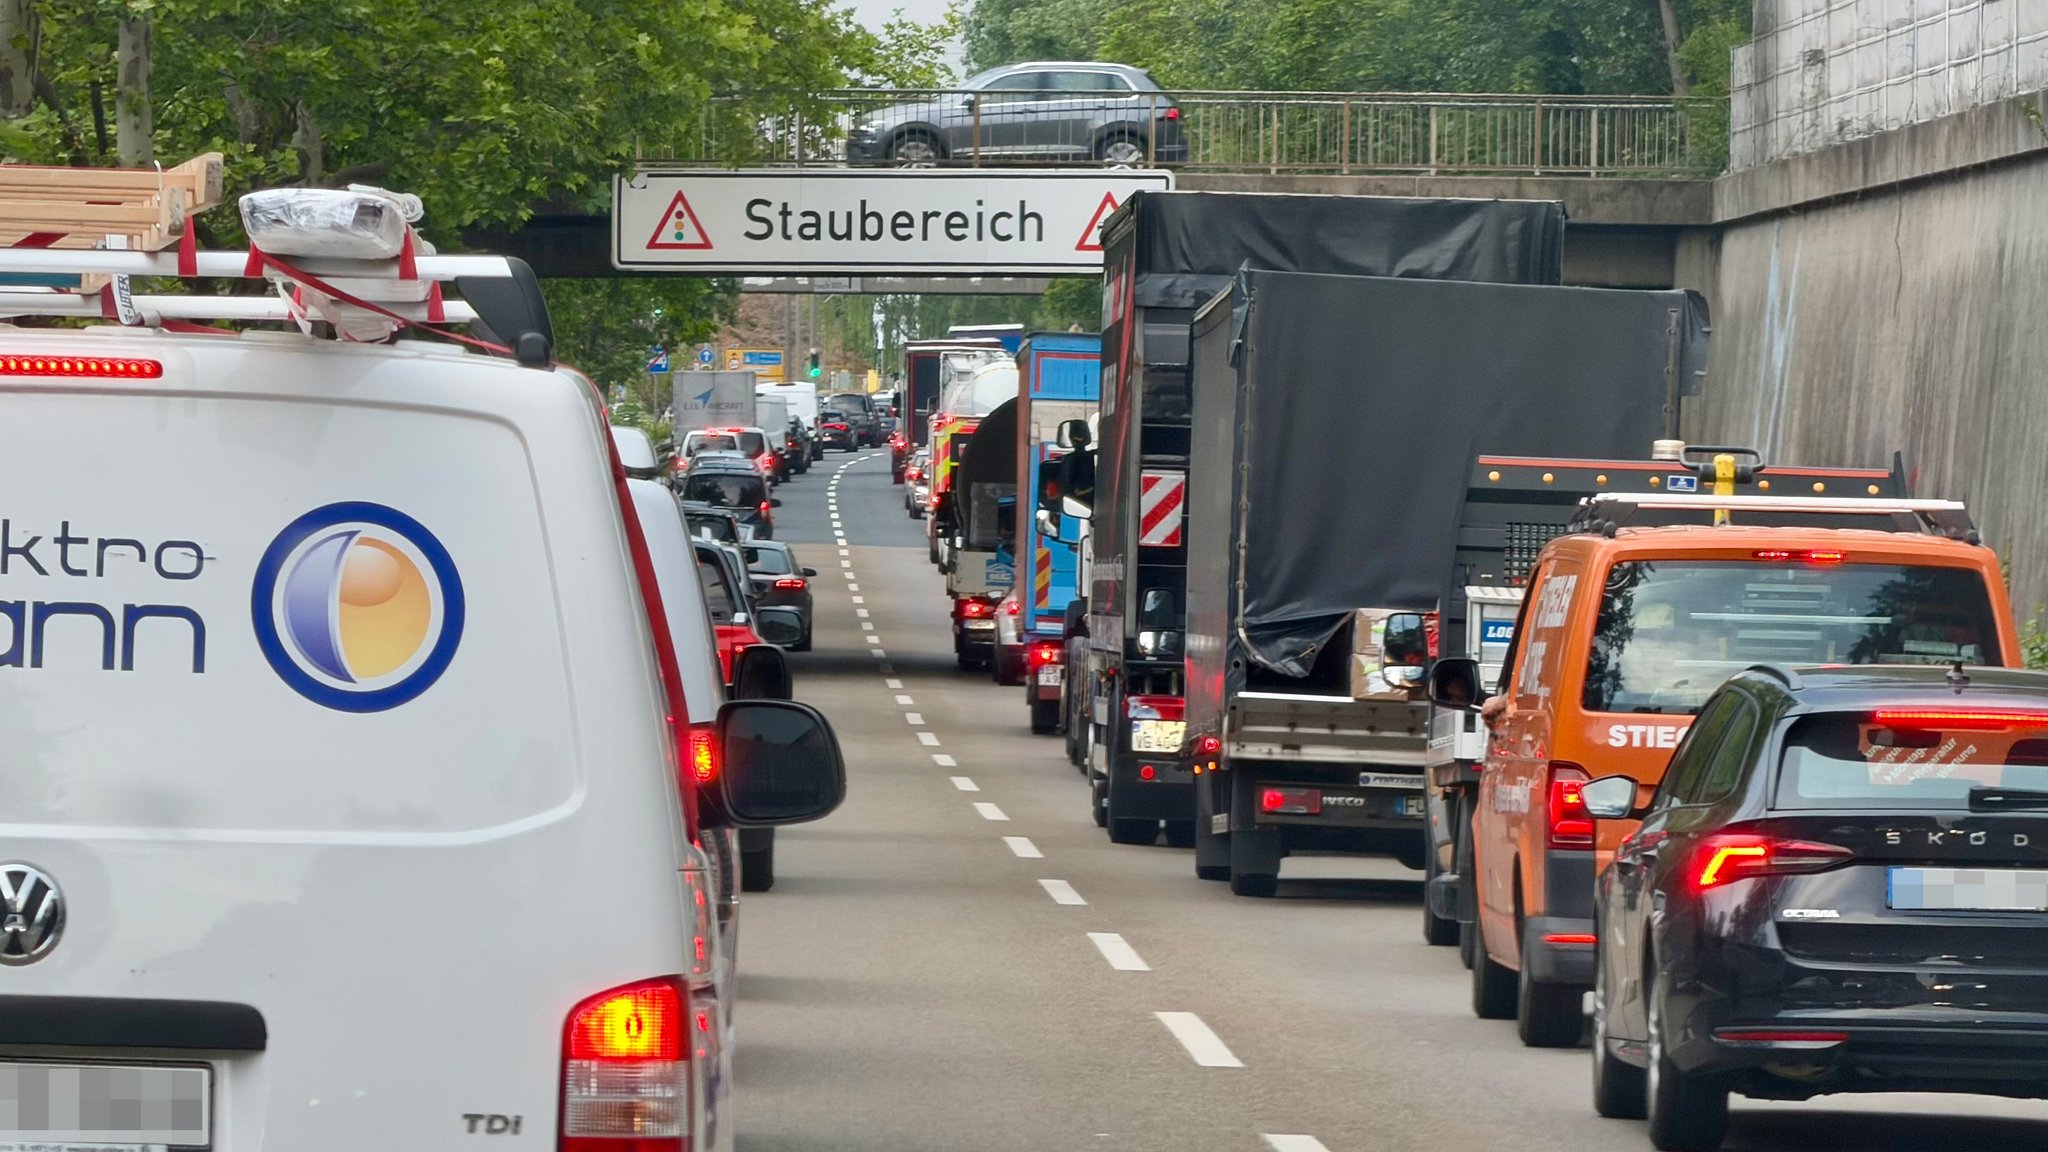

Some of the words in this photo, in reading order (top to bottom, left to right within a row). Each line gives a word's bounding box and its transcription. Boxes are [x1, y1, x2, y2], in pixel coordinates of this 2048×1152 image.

[744, 198, 1043, 242] Staubereich
[0, 518, 204, 580] ktro
[1322, 796, 1366, 806] IVECO
